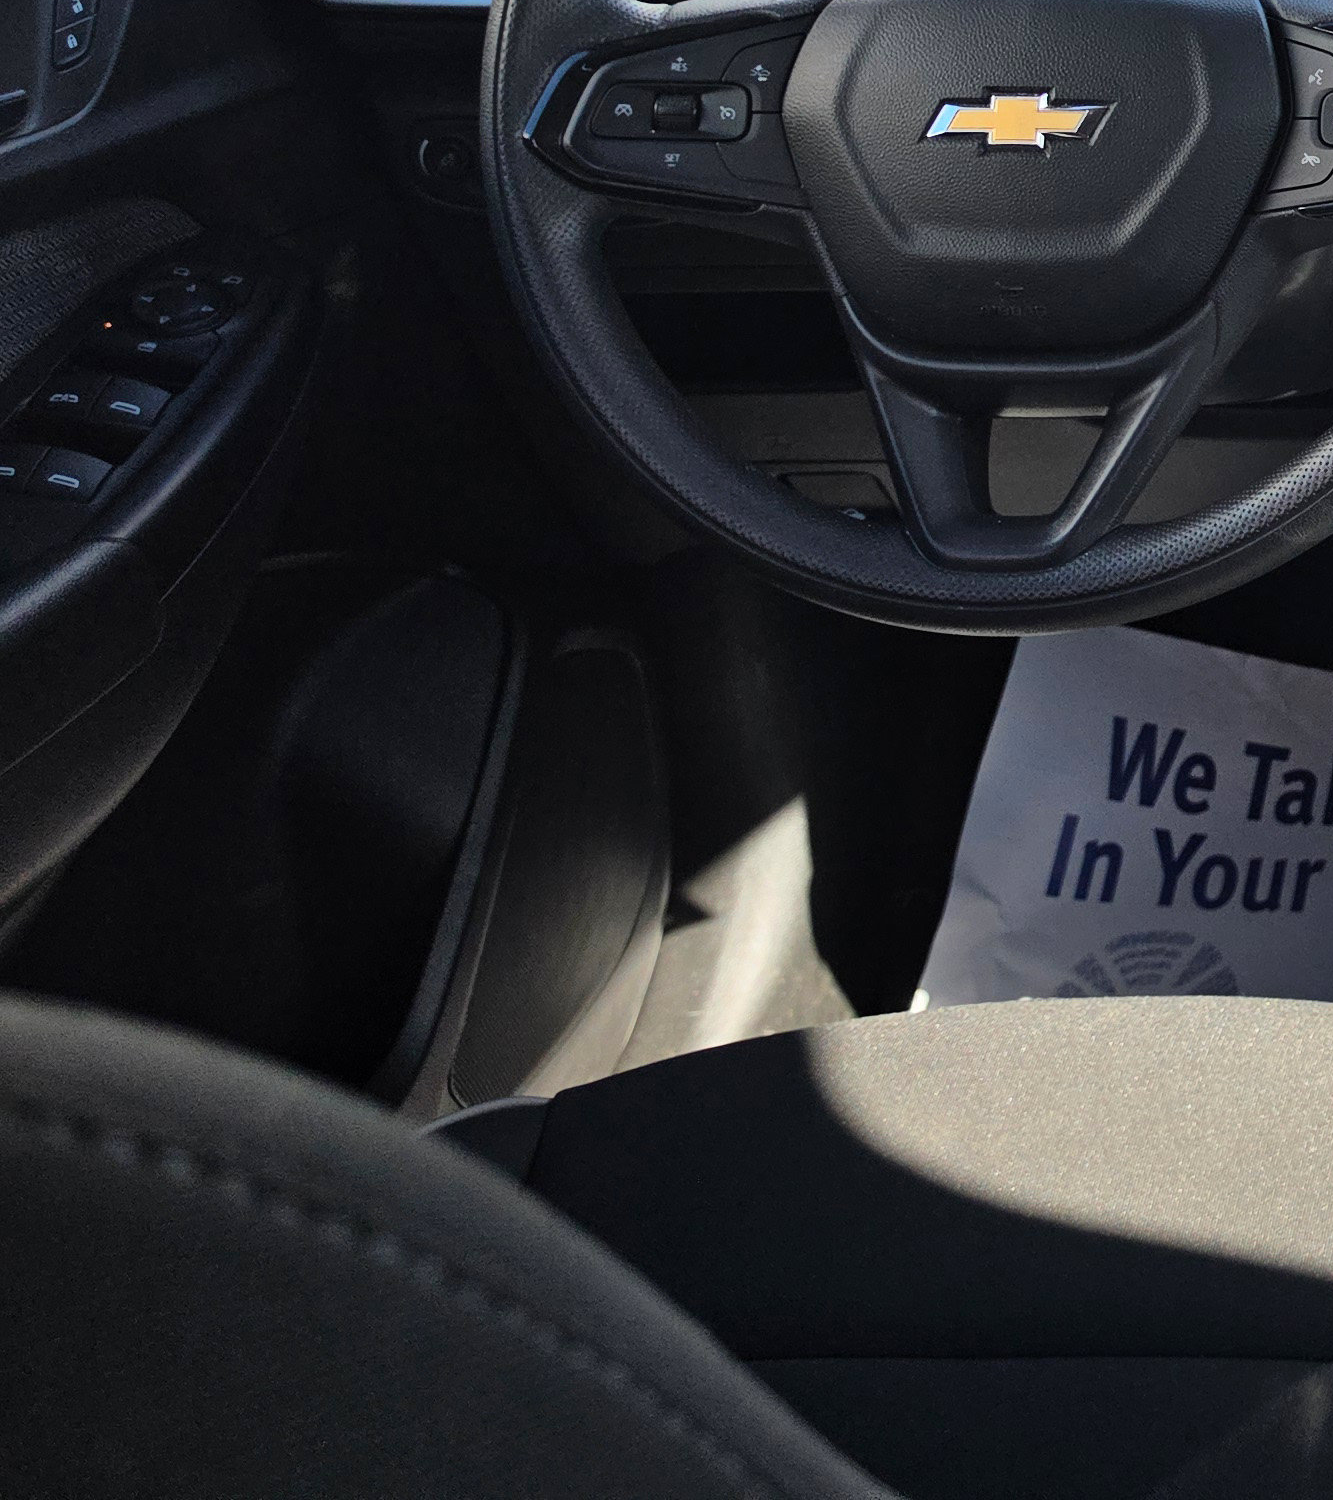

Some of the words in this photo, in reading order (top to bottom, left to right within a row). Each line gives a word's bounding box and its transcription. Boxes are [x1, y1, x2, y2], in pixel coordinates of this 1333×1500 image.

[671, 62, 689, 72] RES
[664, 153, 681, 163] SET
[1107, 716, 1217, 815] We
[1046, 813, 1124, 902] In
[1154, 828, 1326, 915] Your
